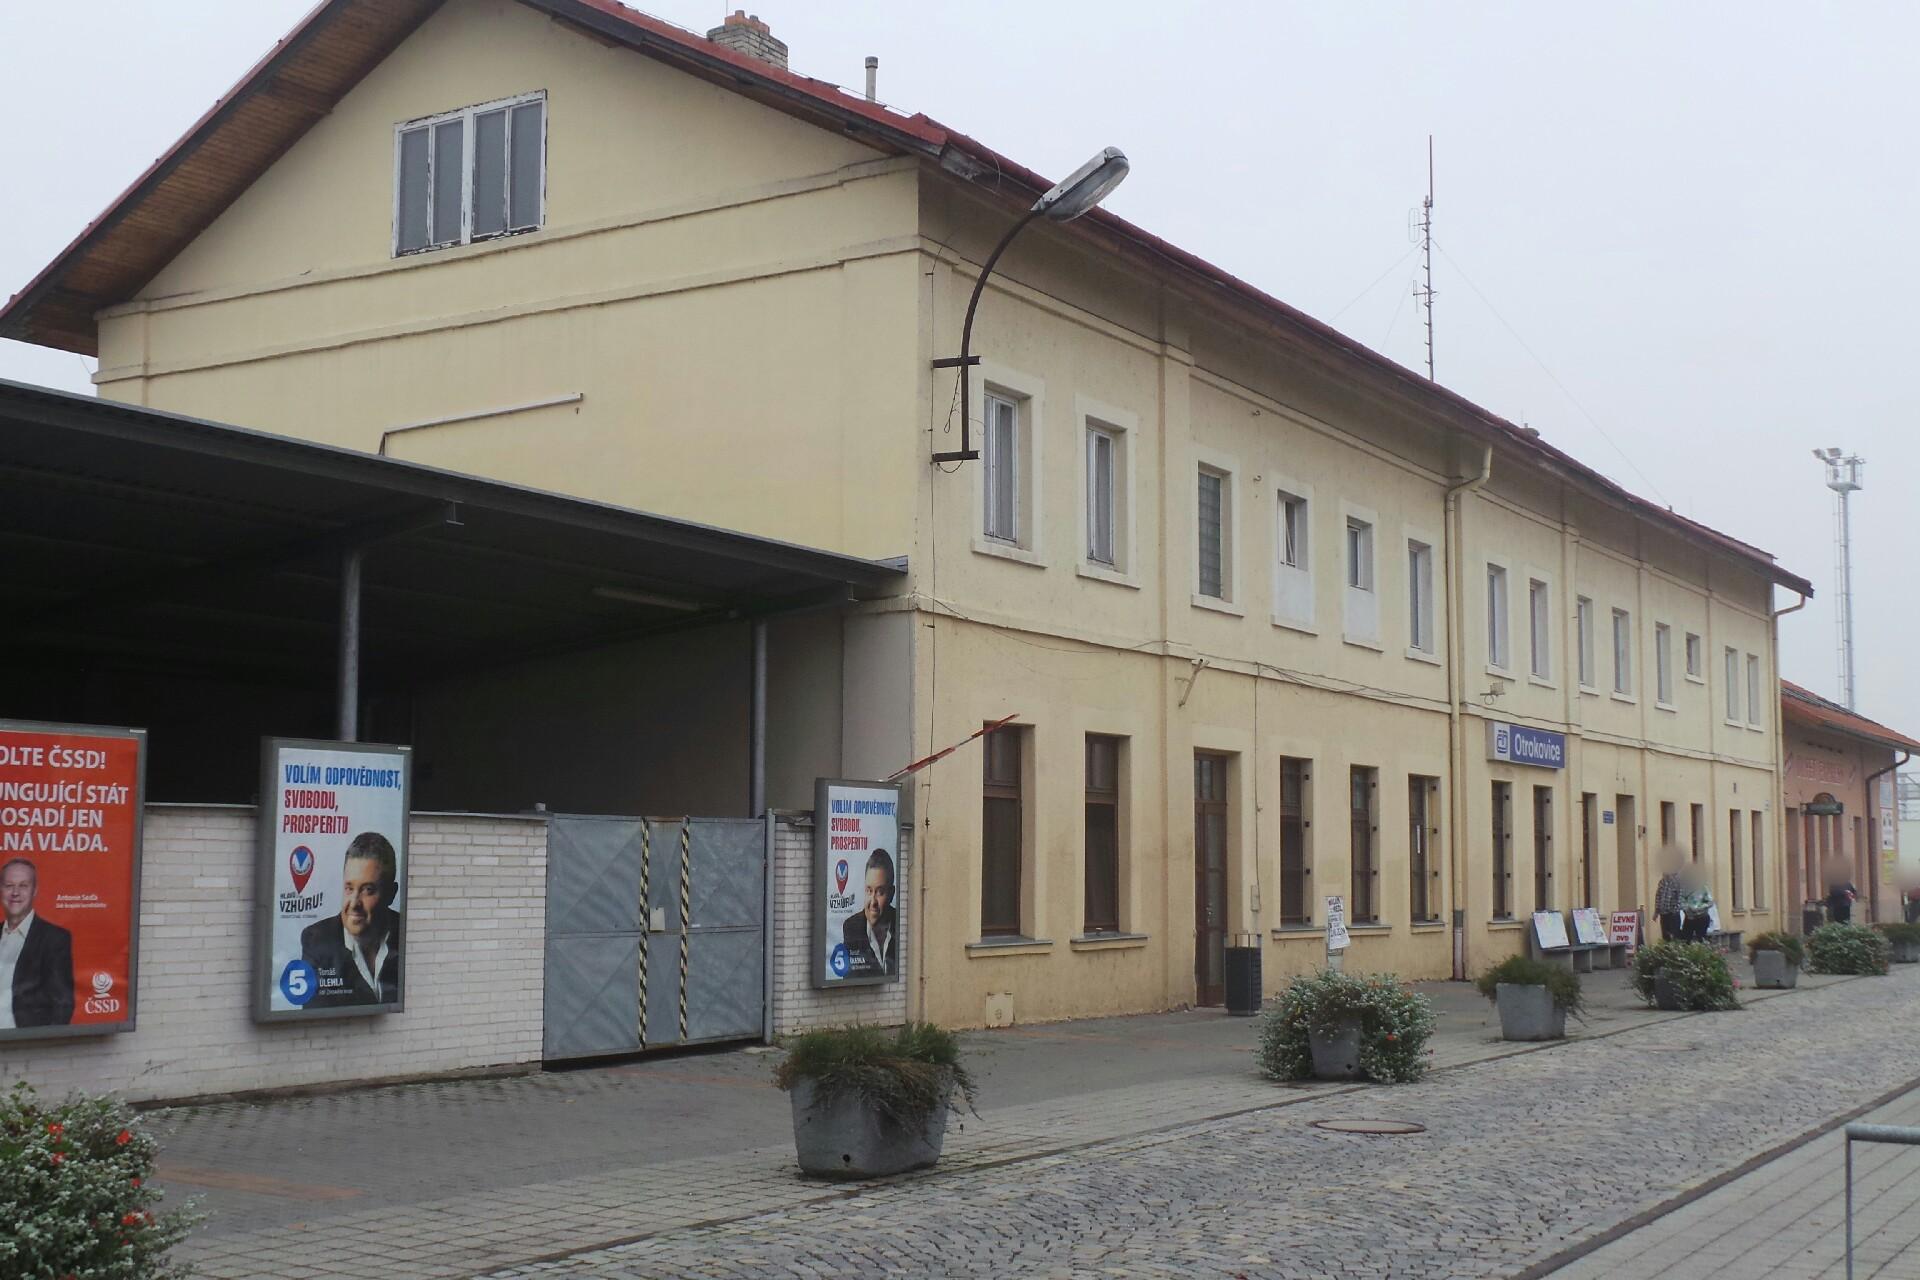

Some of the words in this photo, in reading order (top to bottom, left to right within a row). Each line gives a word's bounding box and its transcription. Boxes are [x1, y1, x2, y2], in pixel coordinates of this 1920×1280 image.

[48, 744, 106, 769] ČSSD!
[1514, 733, 1561, 761] Otrokovice
[285, 763, 321, 785] VOLÍM
[325, 766, 401, 790] ODPOVĚDNOST,
[0, 780, 84, 803] NGUJÍCÍ
[86, 782, 129, 805] STÁT
[284, 789, 339, 812] SVOBODU,
[0, 804, 66, 827] OSADÍ
[67, 809, 103, 828] JEN
[283, 814, 349, 834] PROSPERITU
[0, 828, 35, 852] NÁ
[37, 829, 109, 852] VLÁDA.
[831, 836, 868, 850] PROSPERITU
[1613, 915, 1635, 923] LEVNÉ
[835, 951, 845, 970] 5
[289, 969, 308, 996] 5
[84, 997, 120, 1014] ČSSD
